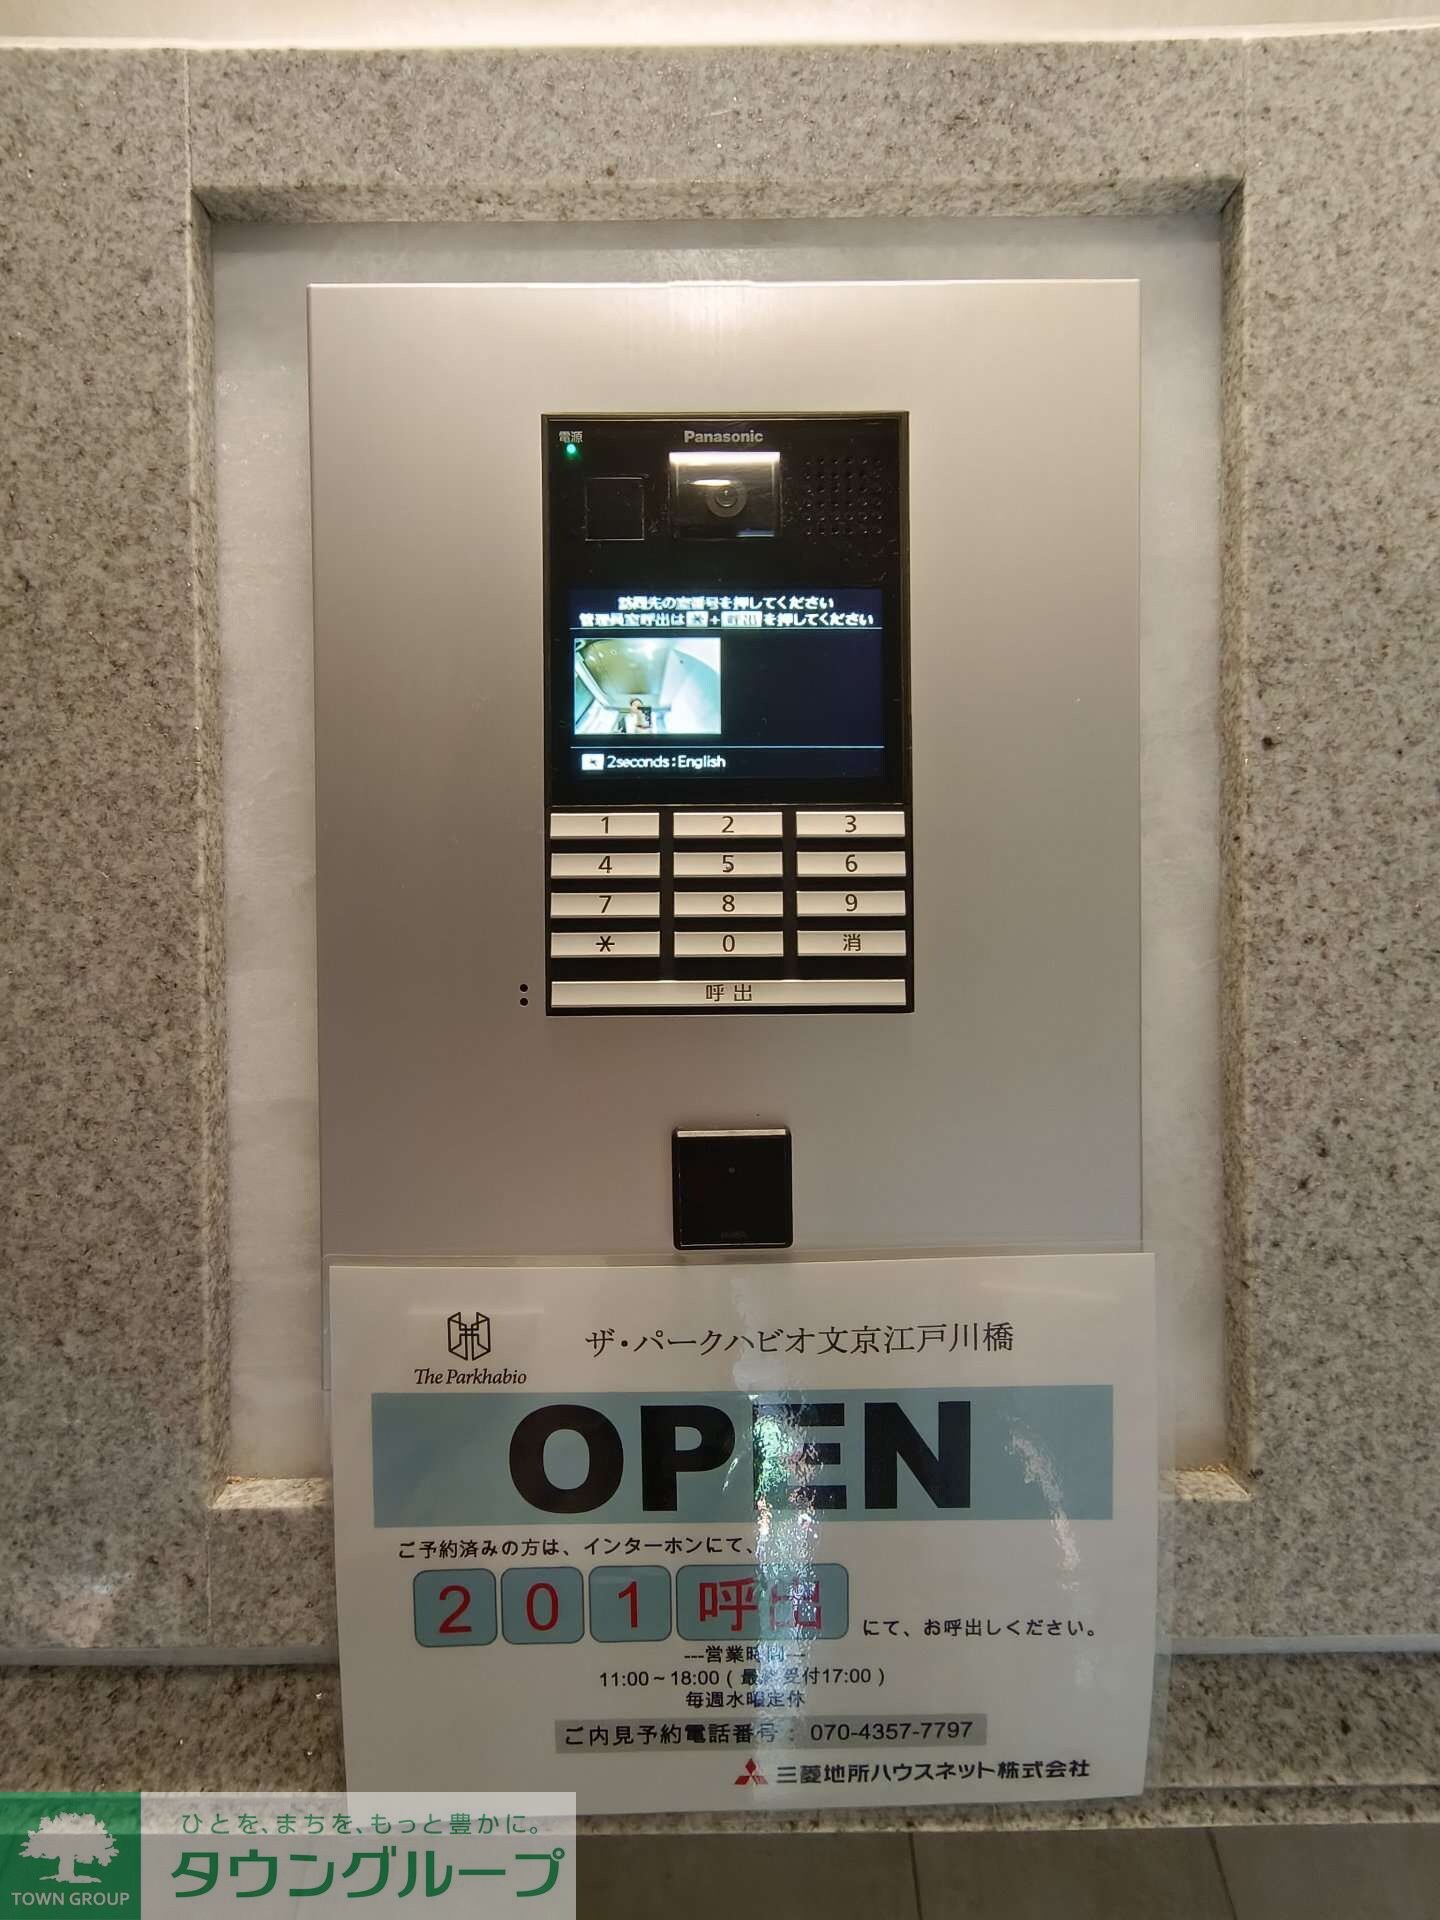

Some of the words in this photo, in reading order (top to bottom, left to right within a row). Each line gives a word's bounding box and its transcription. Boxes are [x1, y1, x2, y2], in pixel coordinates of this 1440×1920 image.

[559, 430, 583, 443] 電源
[683, 430, 764, 443] Panasonic
[600, 815, 610, 834] 1
[721, 815, 735, 833] 2
[845, 814, 857, 833] 3
[598, 854, 613, 874] 4
[722, 854, 735, 873] 5
[845, 853, 858, 873] 6
[599, 894, 612, 914] 7
[722, 894, 736, 913] 8
[845, 893, 858, 913] 9
[722, 934, 736, 952] 0
[843, 933, 862, 952] 消
[705, 983, 753, 1002] 呼出
[585, 1321, 1014, 1358] ザ・パークハビオ文京江戸川橋
[414, 1367, 443, 1385] The
[446, 1367, 527, 1385] Parkhabio
[509, 1401, 971, 1514] OPEN
[398, 1536, 757, 1560] ご予約済みの方は、インターホンにて、
[438, 1584, 473, 1634] 2
[525, 1582, 560, 1631] 0
[617, 1579, 639, 1629] 1
[698, 1576, 823, 1633] 呼出
[863, 1618, 1096, 1637] にて、お呼出しください。
[685, 1690, 806, 1709] 毎週水曜定休
[810, 1721, 974, 1742] 070-4357-7797
[776, 1760, 1090, 1785] 三菱地所ハウスネット株式会社
